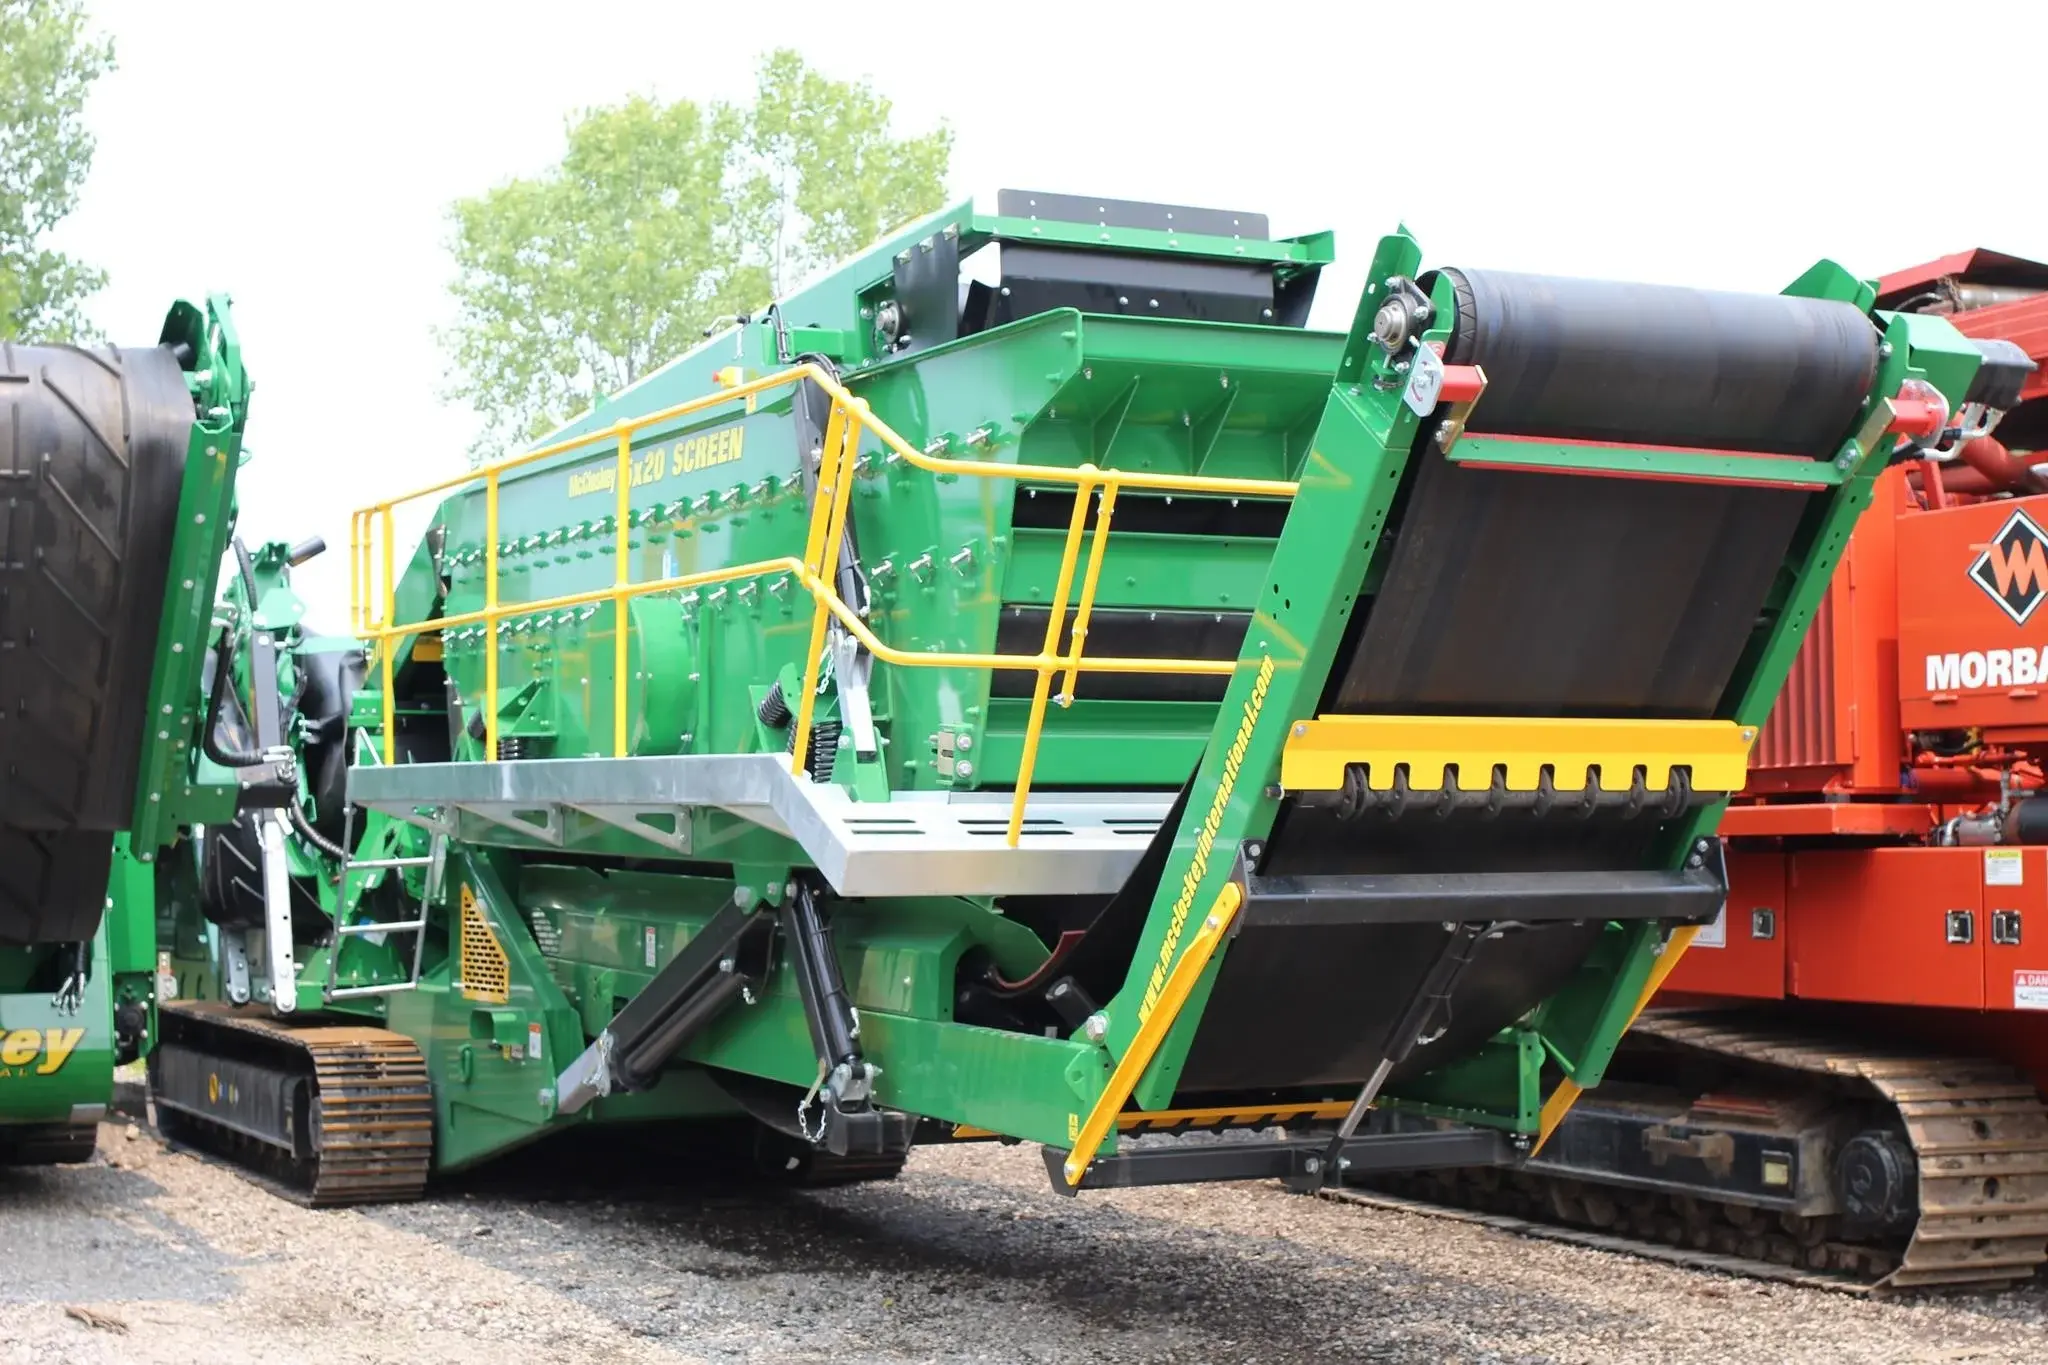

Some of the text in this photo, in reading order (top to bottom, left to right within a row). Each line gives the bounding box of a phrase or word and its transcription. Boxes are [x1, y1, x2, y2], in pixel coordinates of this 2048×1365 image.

[671, 426, 744, 476] SCREEN
[1137, 653, 1275, 1025] www.mccloskeyinternational.com
[0, 1027, 86, 1075] ey
